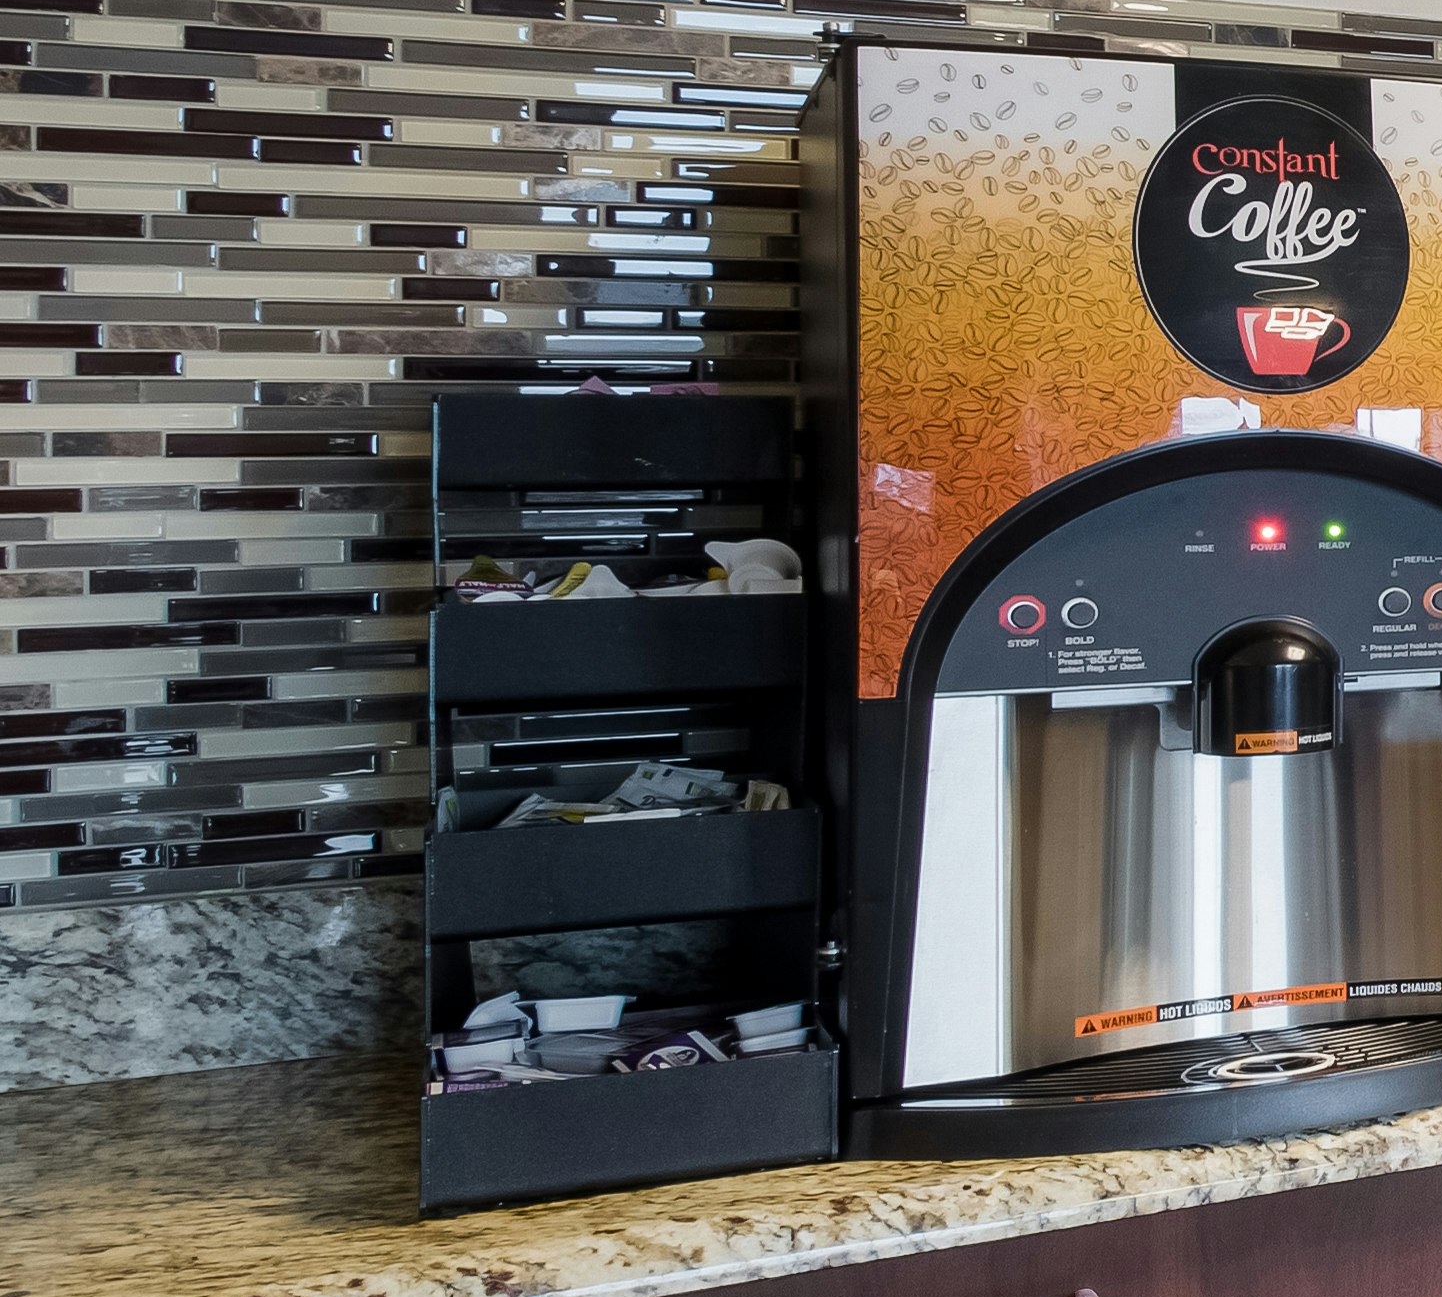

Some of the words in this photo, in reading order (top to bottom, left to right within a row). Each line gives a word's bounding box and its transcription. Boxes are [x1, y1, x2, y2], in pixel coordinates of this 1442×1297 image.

[1188, 173, 1361, 260] Coffee
[1184, 544, 1215, 553] RINSE
[1250, 543, 1286, 552] POWER
[1318, 541, 1351, 550] READY
[1404, 555, 1435, 564] REFILL
[1372, 624, 1417, 633] REGULAR
[1007, 639, 1039, 648] STOP!
[1065, 636, 1094, 645] BOLD
[1252, 737, 1295, 748] WARNING
[1101, 1011, 1153, 1030] WARNING
[1159, 1006, 1183, 1020] HOT
[1186, 999, 1231, 1016] LIQUIDS
[1256, 987, 1345, 1003] AVERTISSEMENT
[1350, 984, 1398, 997] LIQUIDES
[1400, 981, 1442, 993] CHAUDS
